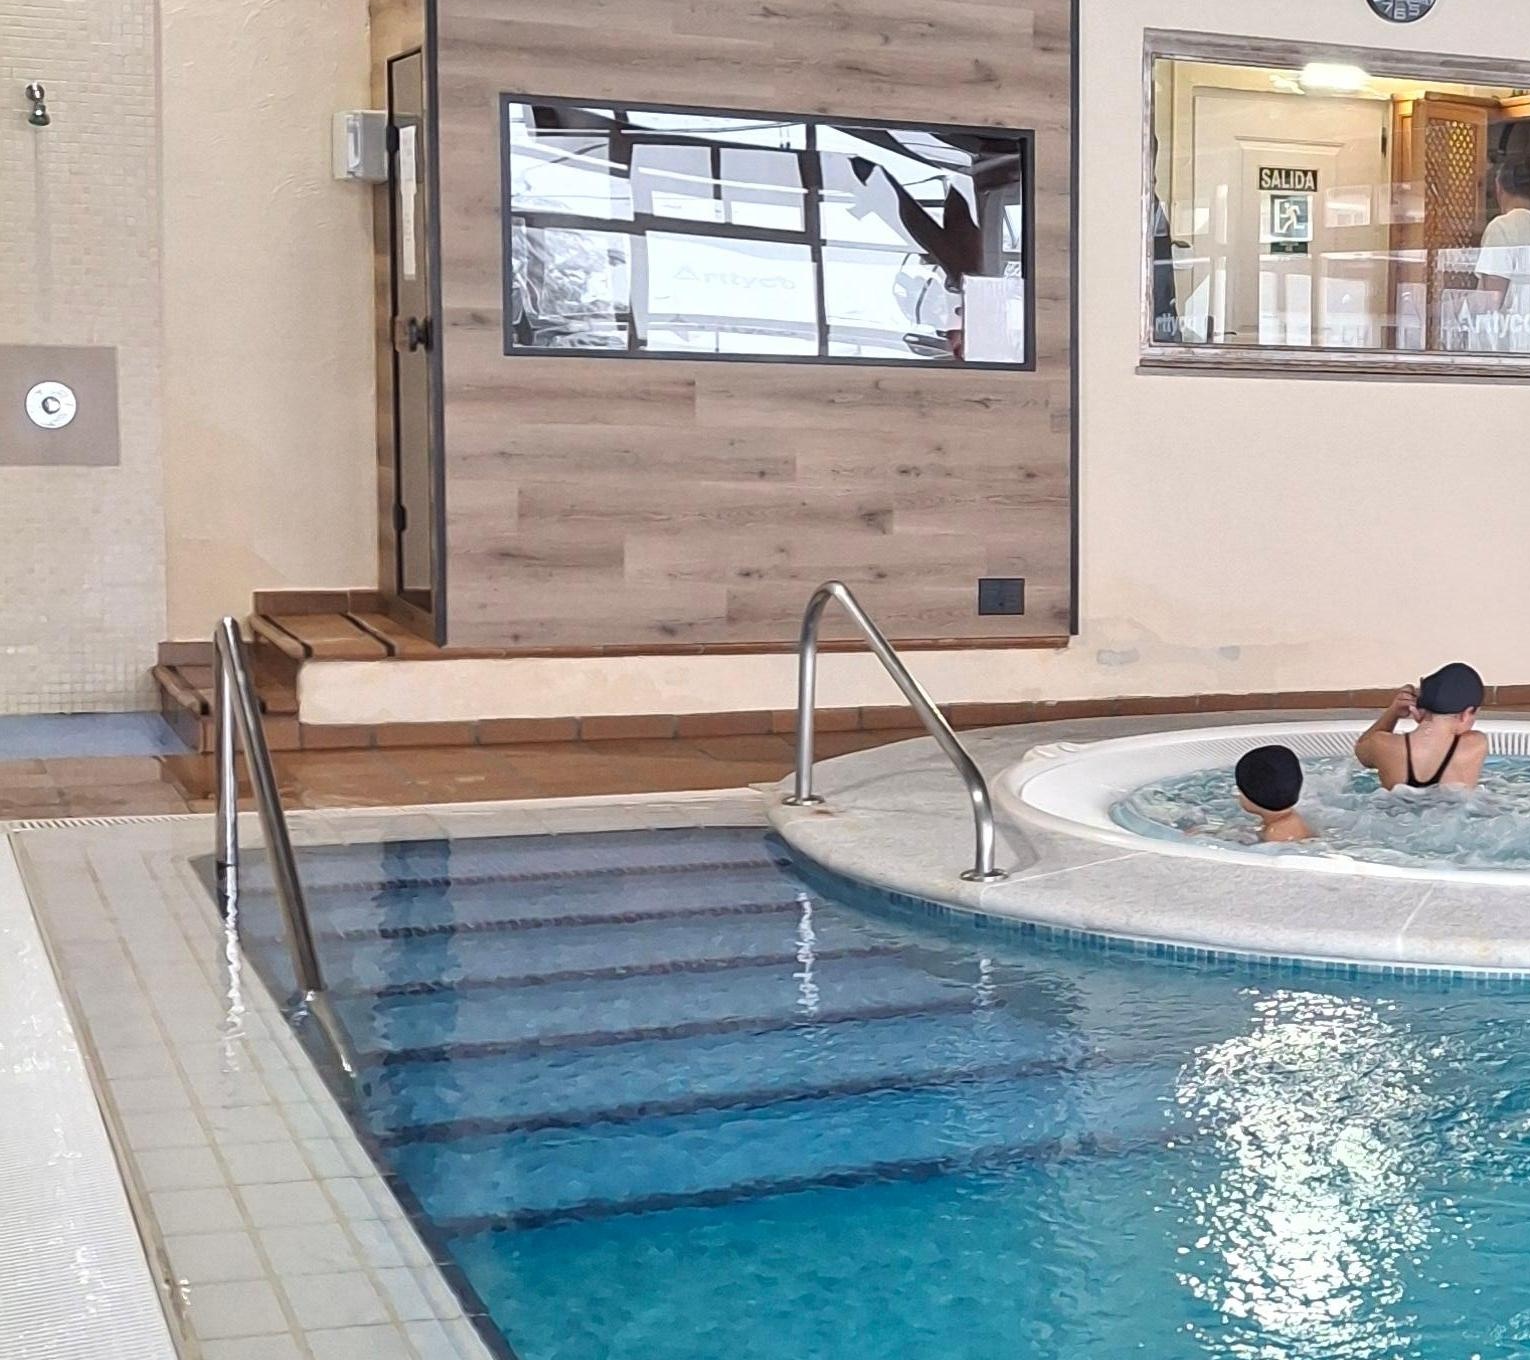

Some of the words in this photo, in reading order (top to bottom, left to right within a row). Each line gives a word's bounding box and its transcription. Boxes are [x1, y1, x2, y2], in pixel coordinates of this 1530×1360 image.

[1381, 1, 1393, 13] 7
[1394, 8, 1406, 20] 6
[1261, 168, 1315, 190] SALIDA
